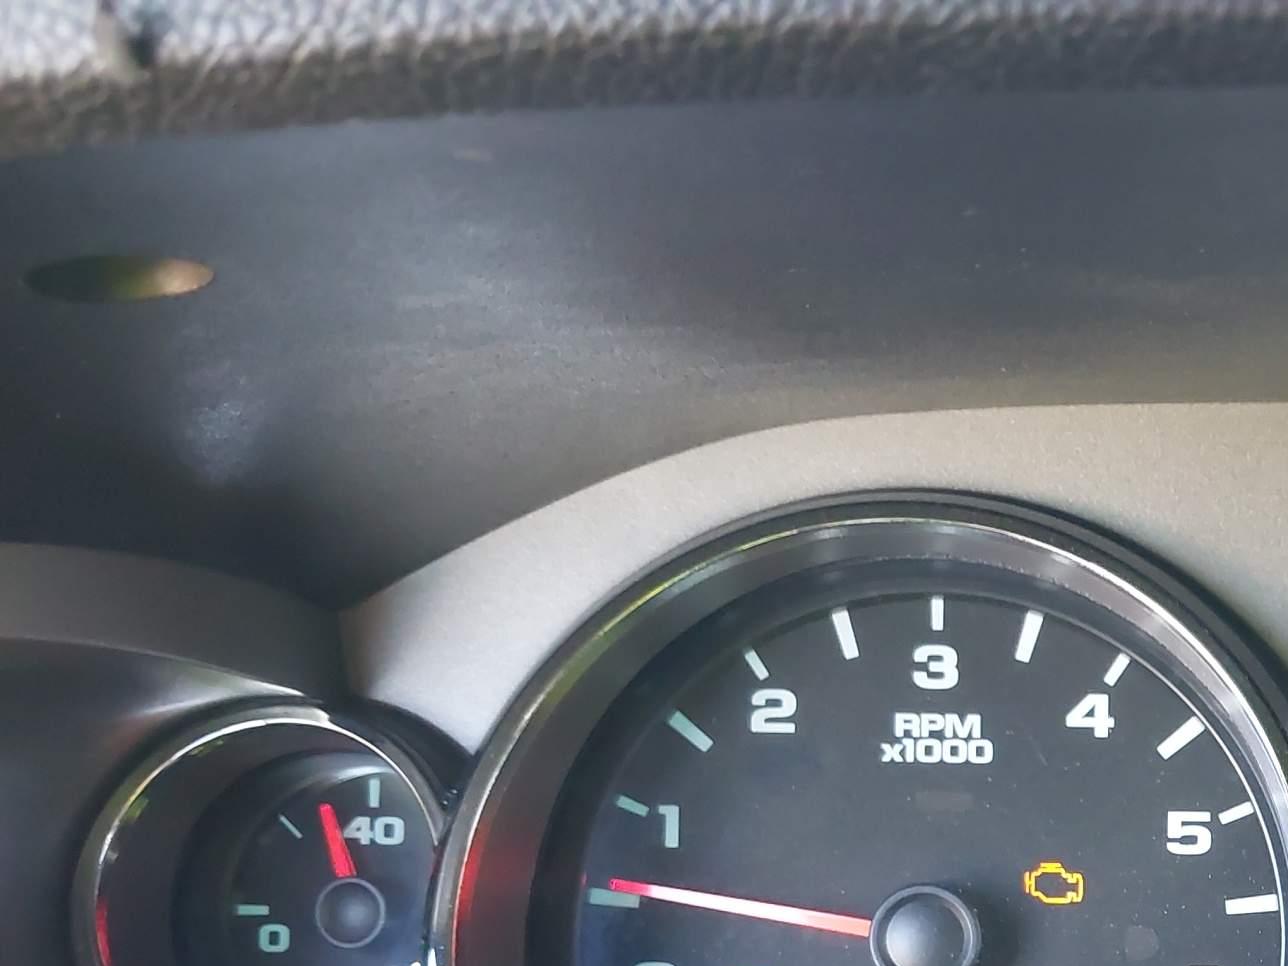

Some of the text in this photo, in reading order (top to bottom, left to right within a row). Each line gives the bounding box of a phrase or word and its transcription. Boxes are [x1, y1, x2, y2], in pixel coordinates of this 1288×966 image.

[912, 645, 959, 690] 3
[750, 689, 797, 734] 2
[895, 714, 981, 739] RPM
[1065, 693, 1115, 738] 4
[881, 739, 993, 764] x1000
[343, 816, 404, 845] 40
[658, 805, 680, 848] 1
[1166, 810, 1212, 856] 5
[258, 924, 290, 953] 0
